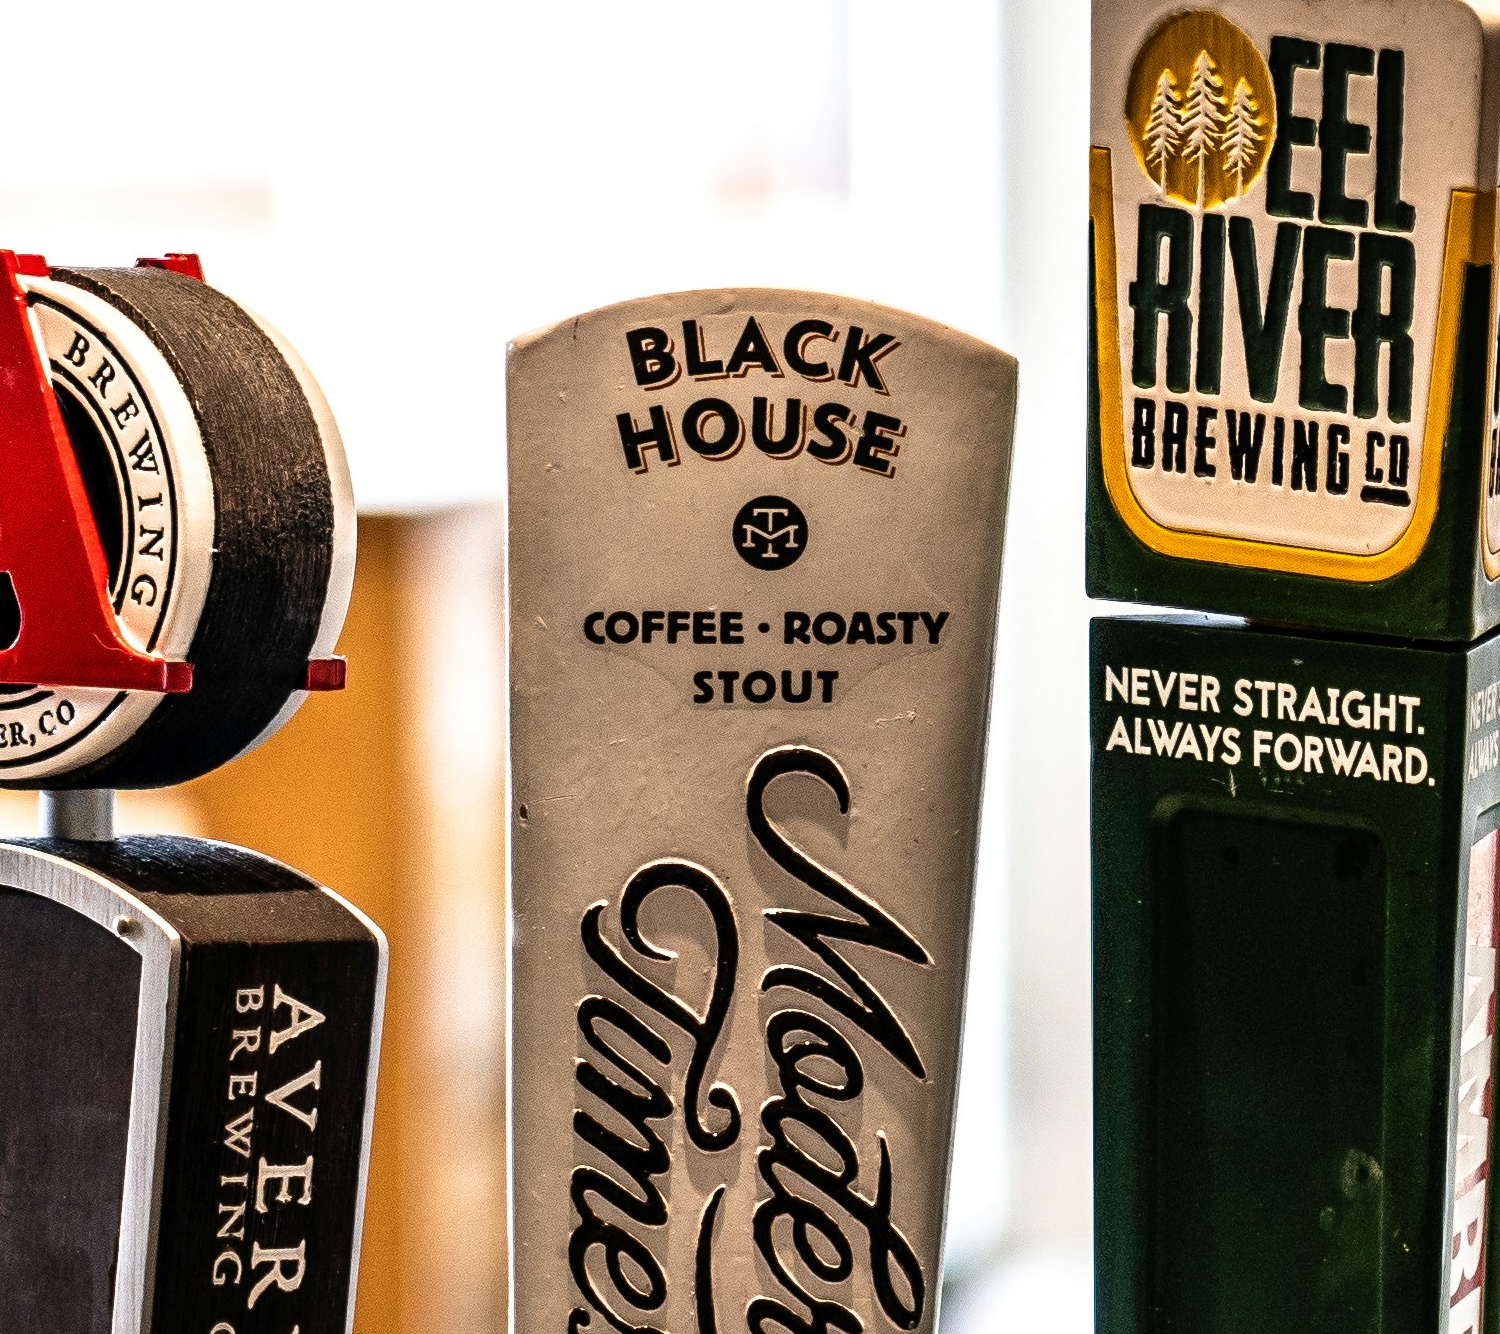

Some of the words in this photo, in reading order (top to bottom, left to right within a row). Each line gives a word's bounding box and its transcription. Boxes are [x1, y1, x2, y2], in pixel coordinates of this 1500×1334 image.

[1266, 35, 1416, 233] EEL
[1129, 204, 1416, 422] RIVER
[626, 315, 901, 396] BLACK
[62, 331, 166, 610] BREWING
[616, 396, 908, 479] HOUSE
[1132, 398, 1352, 495] BREWING
[583, 611, 745, 646] COFFEE
[783, 611, 950, 646] ROASTY
[693, 671, 840, 704] STOUT
[1105, 665, 1221, 714] NEVER
[1233, 679, 1425, 735] STRAIGHT.
[1105, 717, 1243, 767] ALWAYS
[1252, 729, 1437, 787] FORWARD.
[213, 984, 265, 1287] BREWING
